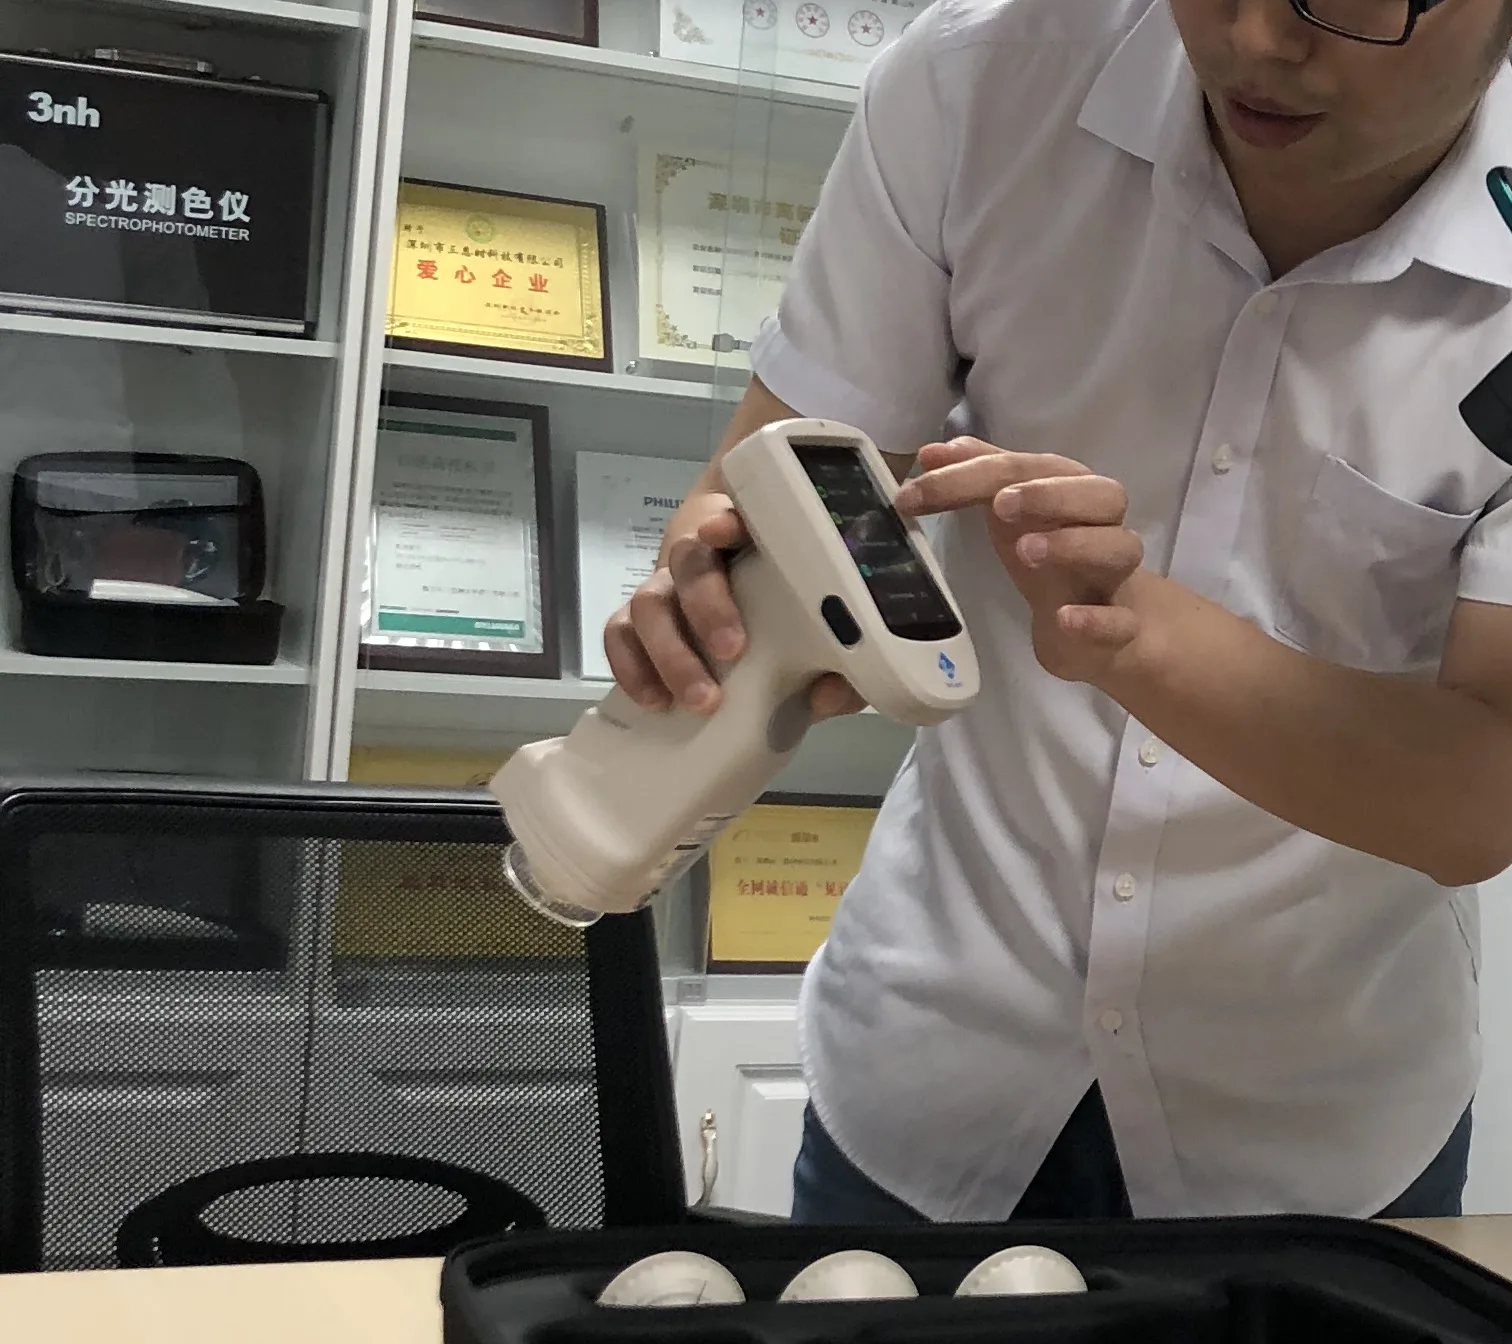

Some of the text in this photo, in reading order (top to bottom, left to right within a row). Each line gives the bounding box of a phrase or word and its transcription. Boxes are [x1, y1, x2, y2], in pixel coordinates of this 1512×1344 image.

[27, 91, 100, 128] 3nh
[65, 175, 251, 223] 分光测色仪
[65, 211, 250, 241] SPECTROPHOTOMETER
[416, 259, 549, 293] 爱心企业
